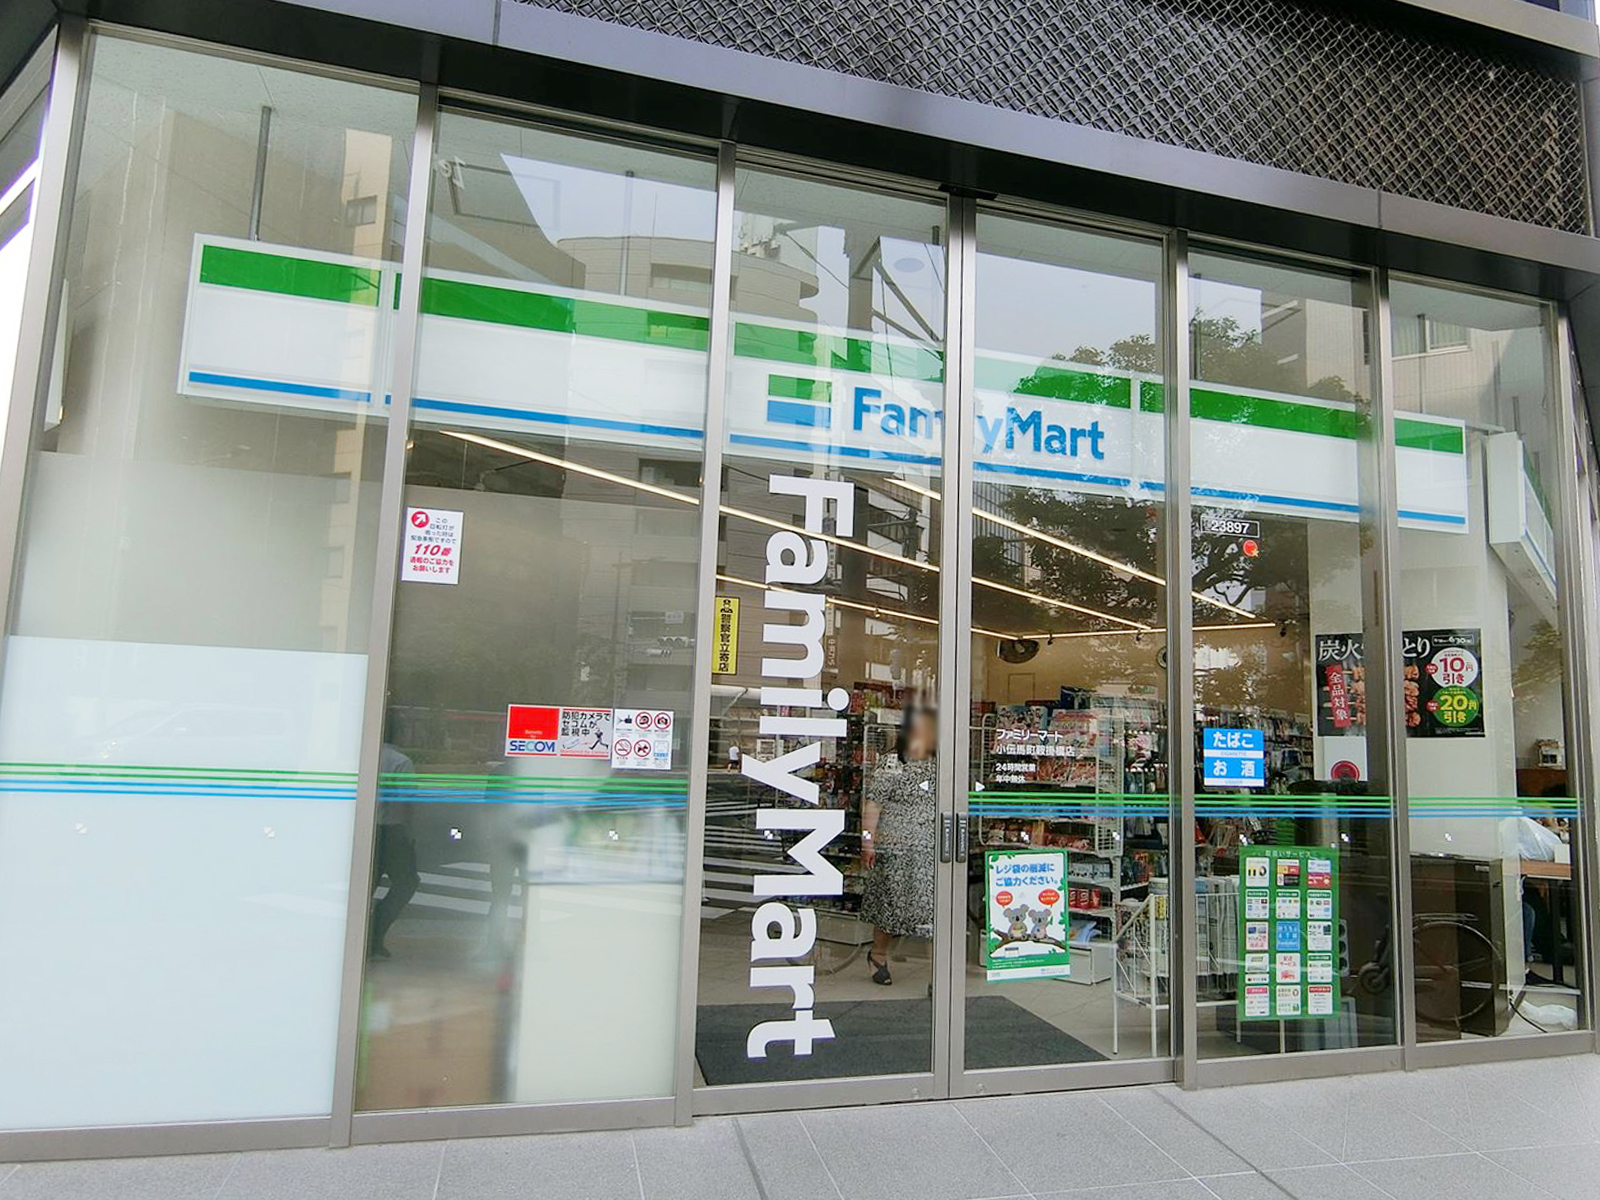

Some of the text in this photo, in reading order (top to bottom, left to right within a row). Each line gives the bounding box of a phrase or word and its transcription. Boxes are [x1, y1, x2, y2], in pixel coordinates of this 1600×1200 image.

[853, 386, 1105, 461] FamyMart
[1211, 520, 1250, 534] 23897
[414, 543, 452, 556] 110番
[1329, 671, 1348, 721] 全品対象
[562, 711, 611, 721] 防犯カメラで
[562, 720, 597, 729] セコムが
[561, 728, 590, 737] 監視中
[996, 728, 1064, 742] ファミリーマート
[509, 740, 556, 752] SECOM
[1213, 731, 1254, 748] たばこ
[741, 473, 855, 1060] FamilyMart
[995, 862, 1055, 875] レジ袋の削減に
